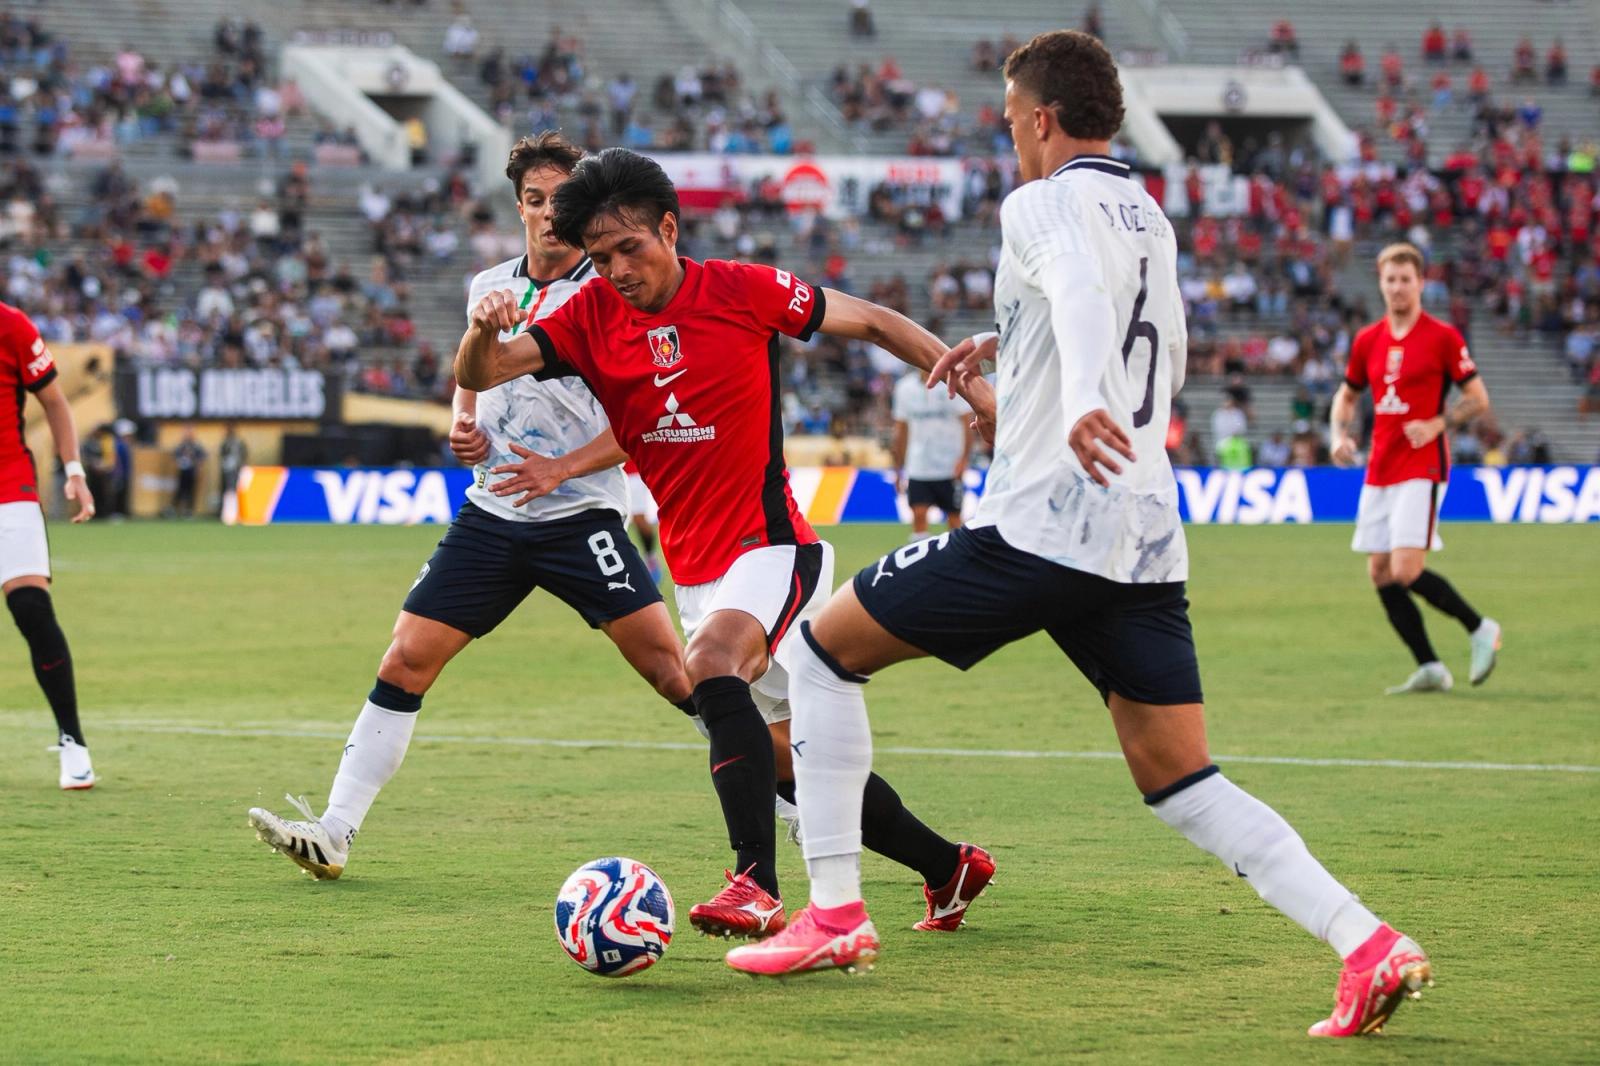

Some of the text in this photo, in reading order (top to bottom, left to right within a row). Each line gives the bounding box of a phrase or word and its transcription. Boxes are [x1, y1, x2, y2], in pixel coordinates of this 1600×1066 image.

[137, 368, 326, 418] LOS ANGELES
[313, 470, 452, 524] VISA
[1175, 468, 1313, 524] VISA
[1473, 466, 1600, 524] VISA
[587, 530, 625, 576] 8
[895, 531, 950, 570] 6
